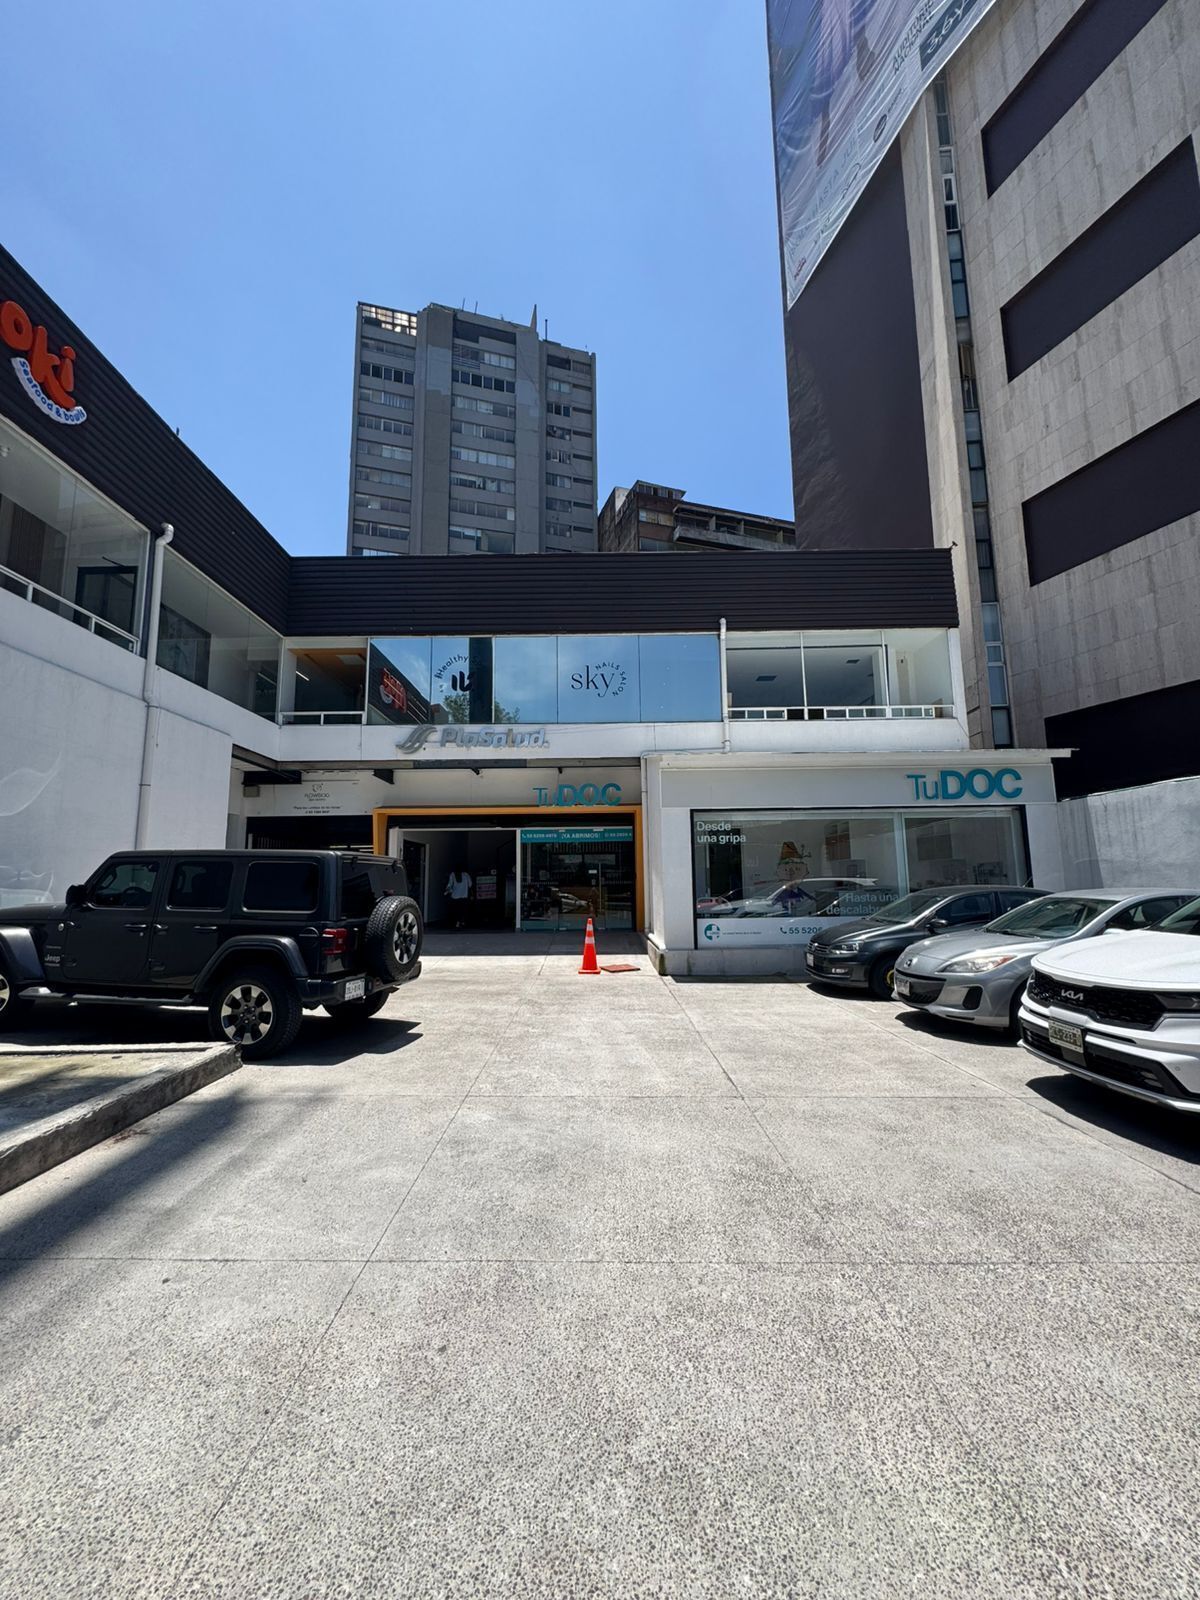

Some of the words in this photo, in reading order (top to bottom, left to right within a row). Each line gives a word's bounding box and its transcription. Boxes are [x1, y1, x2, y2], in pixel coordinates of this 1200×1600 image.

[19, 360, 54, 411] Seafood
[55, 407, 62, 418] &
[571, 665, 615, 698] sky
[595, 661, 620, 671] NAILS
[612, 671, 627, 697] SALON
[906, 768, 1023, 800] TuDOC
[532, 783, 622, 807] TuDOC
[697, 821, 731, 831] Desde
[697, 835, 717, 843] una
[719, 833, 747, 845] gripa
[846, 892, 877, 903] Hasta
[879, 893, 899, 902] una
[826, 905, 880, 915] descalabr
[789, 927, 800, 935] 55
[44, 954, 61, 963] Jeep
[1060, 989, 1084, 1001] KIA
